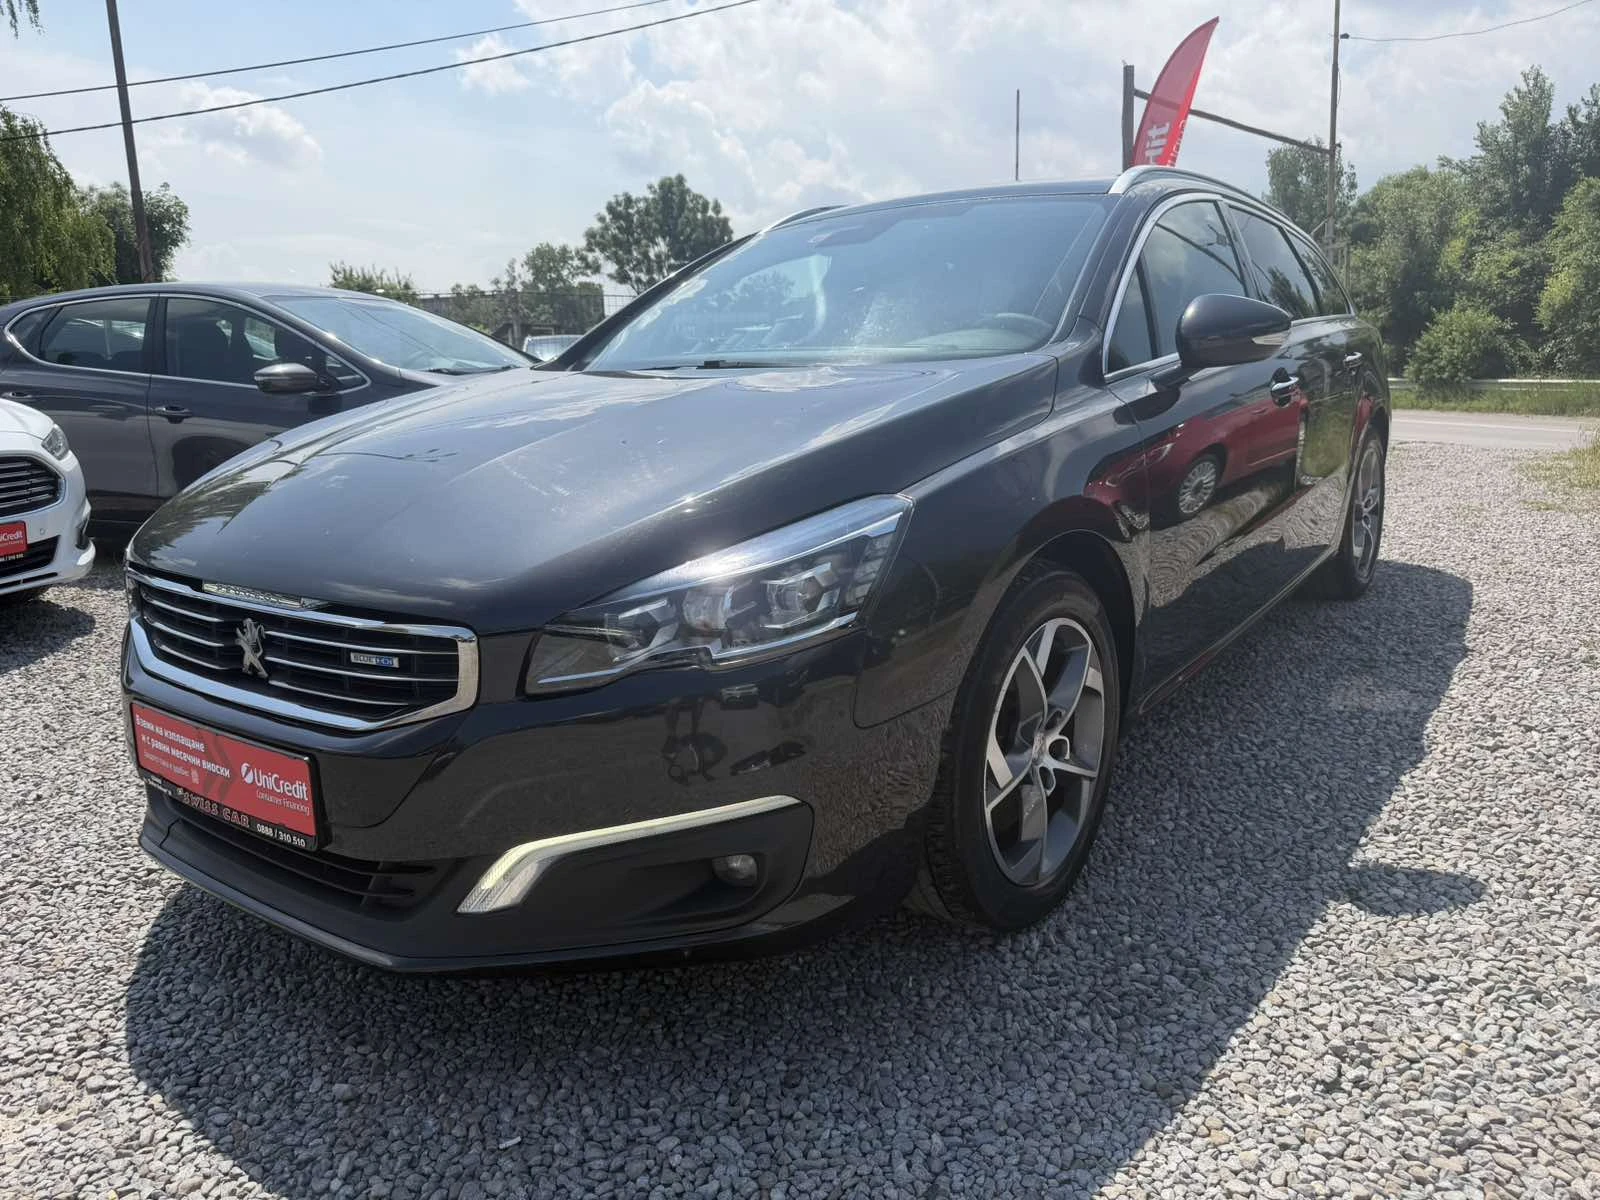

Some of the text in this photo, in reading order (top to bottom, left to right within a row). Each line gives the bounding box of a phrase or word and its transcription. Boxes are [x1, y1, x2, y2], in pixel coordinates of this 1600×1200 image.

[155, 726, 163, 736] на
[164, 728, 205, 752] изплащане
[151, 738, 170, 753] равни
[171, 747, 201, 767] месечни
[202, 759, 230, 778] вноски
[254, 767, 308, 800] UniCredit
[183, 792, 249, 828] SWISS CAR
[279, 831, 291, 843] 310
[292, 836, 306, 847] 510
